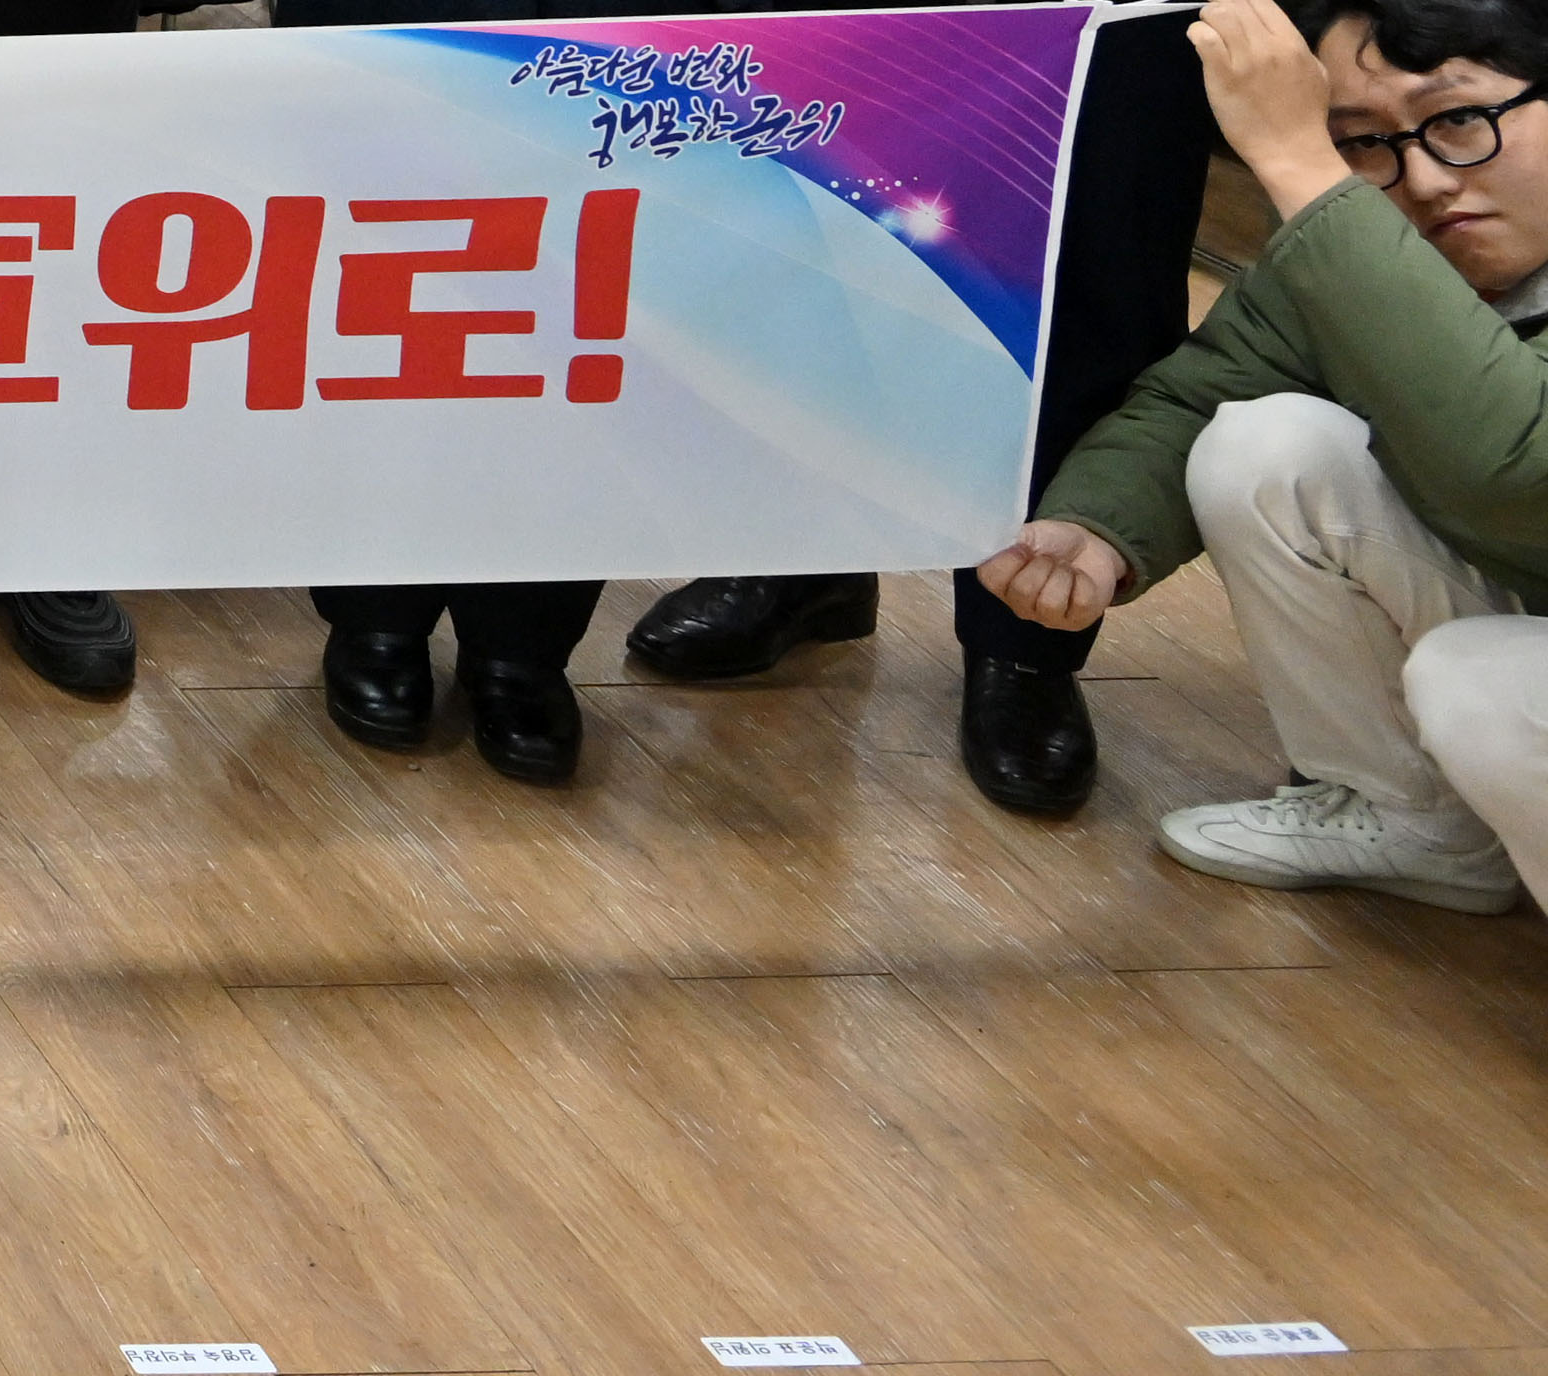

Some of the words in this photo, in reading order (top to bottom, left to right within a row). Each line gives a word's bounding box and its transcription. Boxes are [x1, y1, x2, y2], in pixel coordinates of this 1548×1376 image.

[510, 45, 660, 98] 아름다운
[668, 42, 764, 96] 변화
[587, 97, 738, 170] 행복한
[728, 94, 846, 159] 군위
